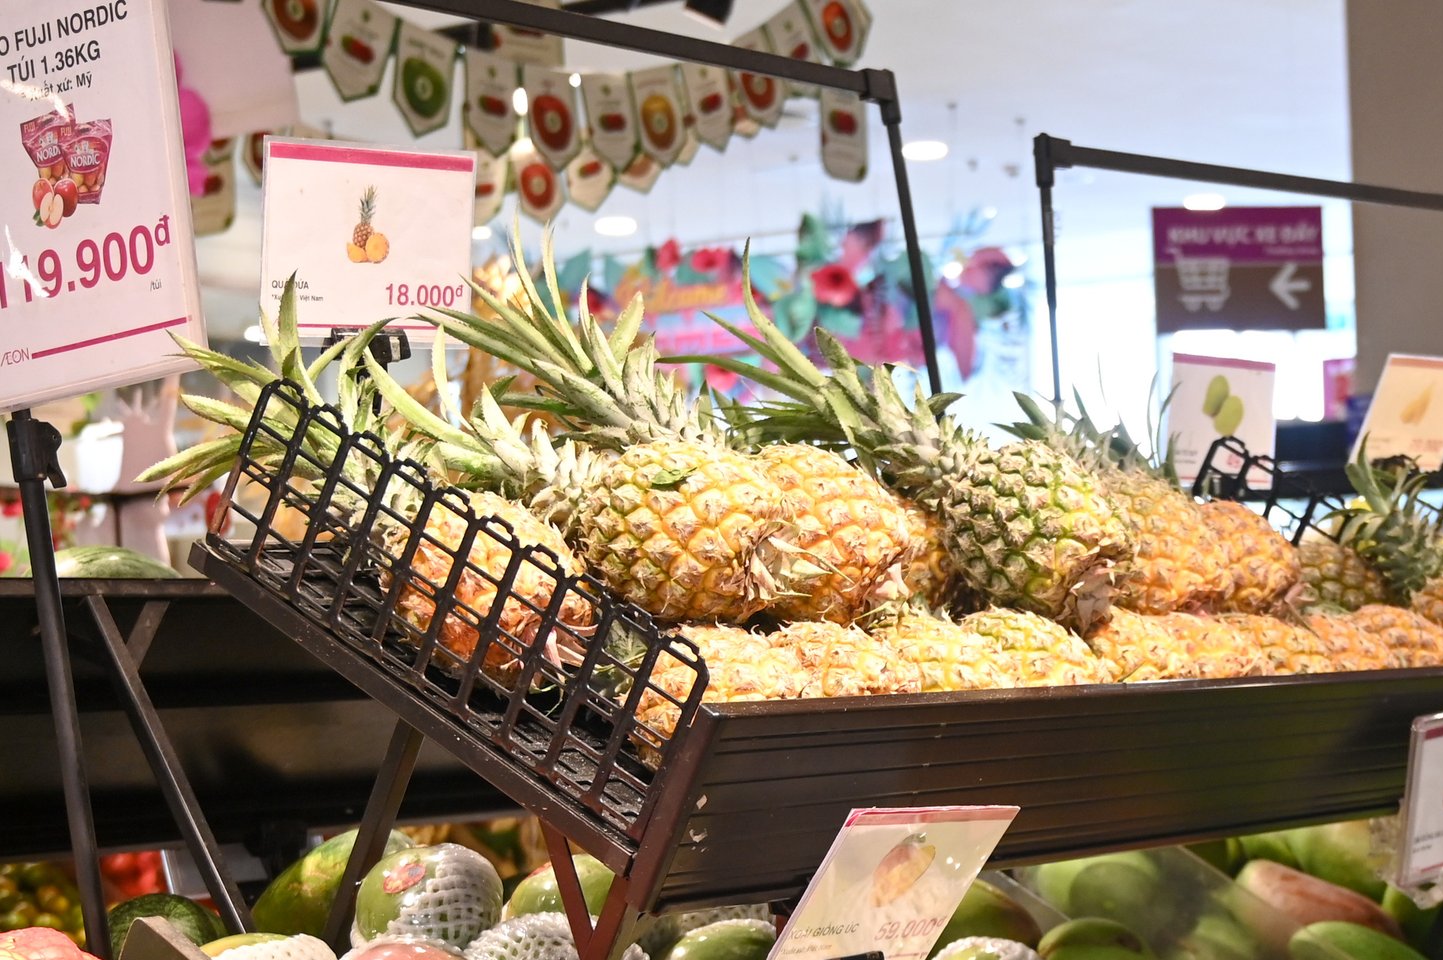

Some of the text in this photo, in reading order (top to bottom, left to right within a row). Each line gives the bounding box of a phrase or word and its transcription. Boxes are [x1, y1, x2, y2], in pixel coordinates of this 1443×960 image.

[14, 22, 52, 52] FUJI
[56, 0, 128, 39] NORDIC
[7, 39, 101, 84] TÚI 1.36KG
[56, 77, 74, 94] xứ:
[75, 70, 93, 89] Mỹ
[36, 144, 62, 163] NORD
[70, 152, 101, 168] NORDIC
[385, 283, 464, 307] 18.000đ
[874, 916, 947, 941] 59.000đ
